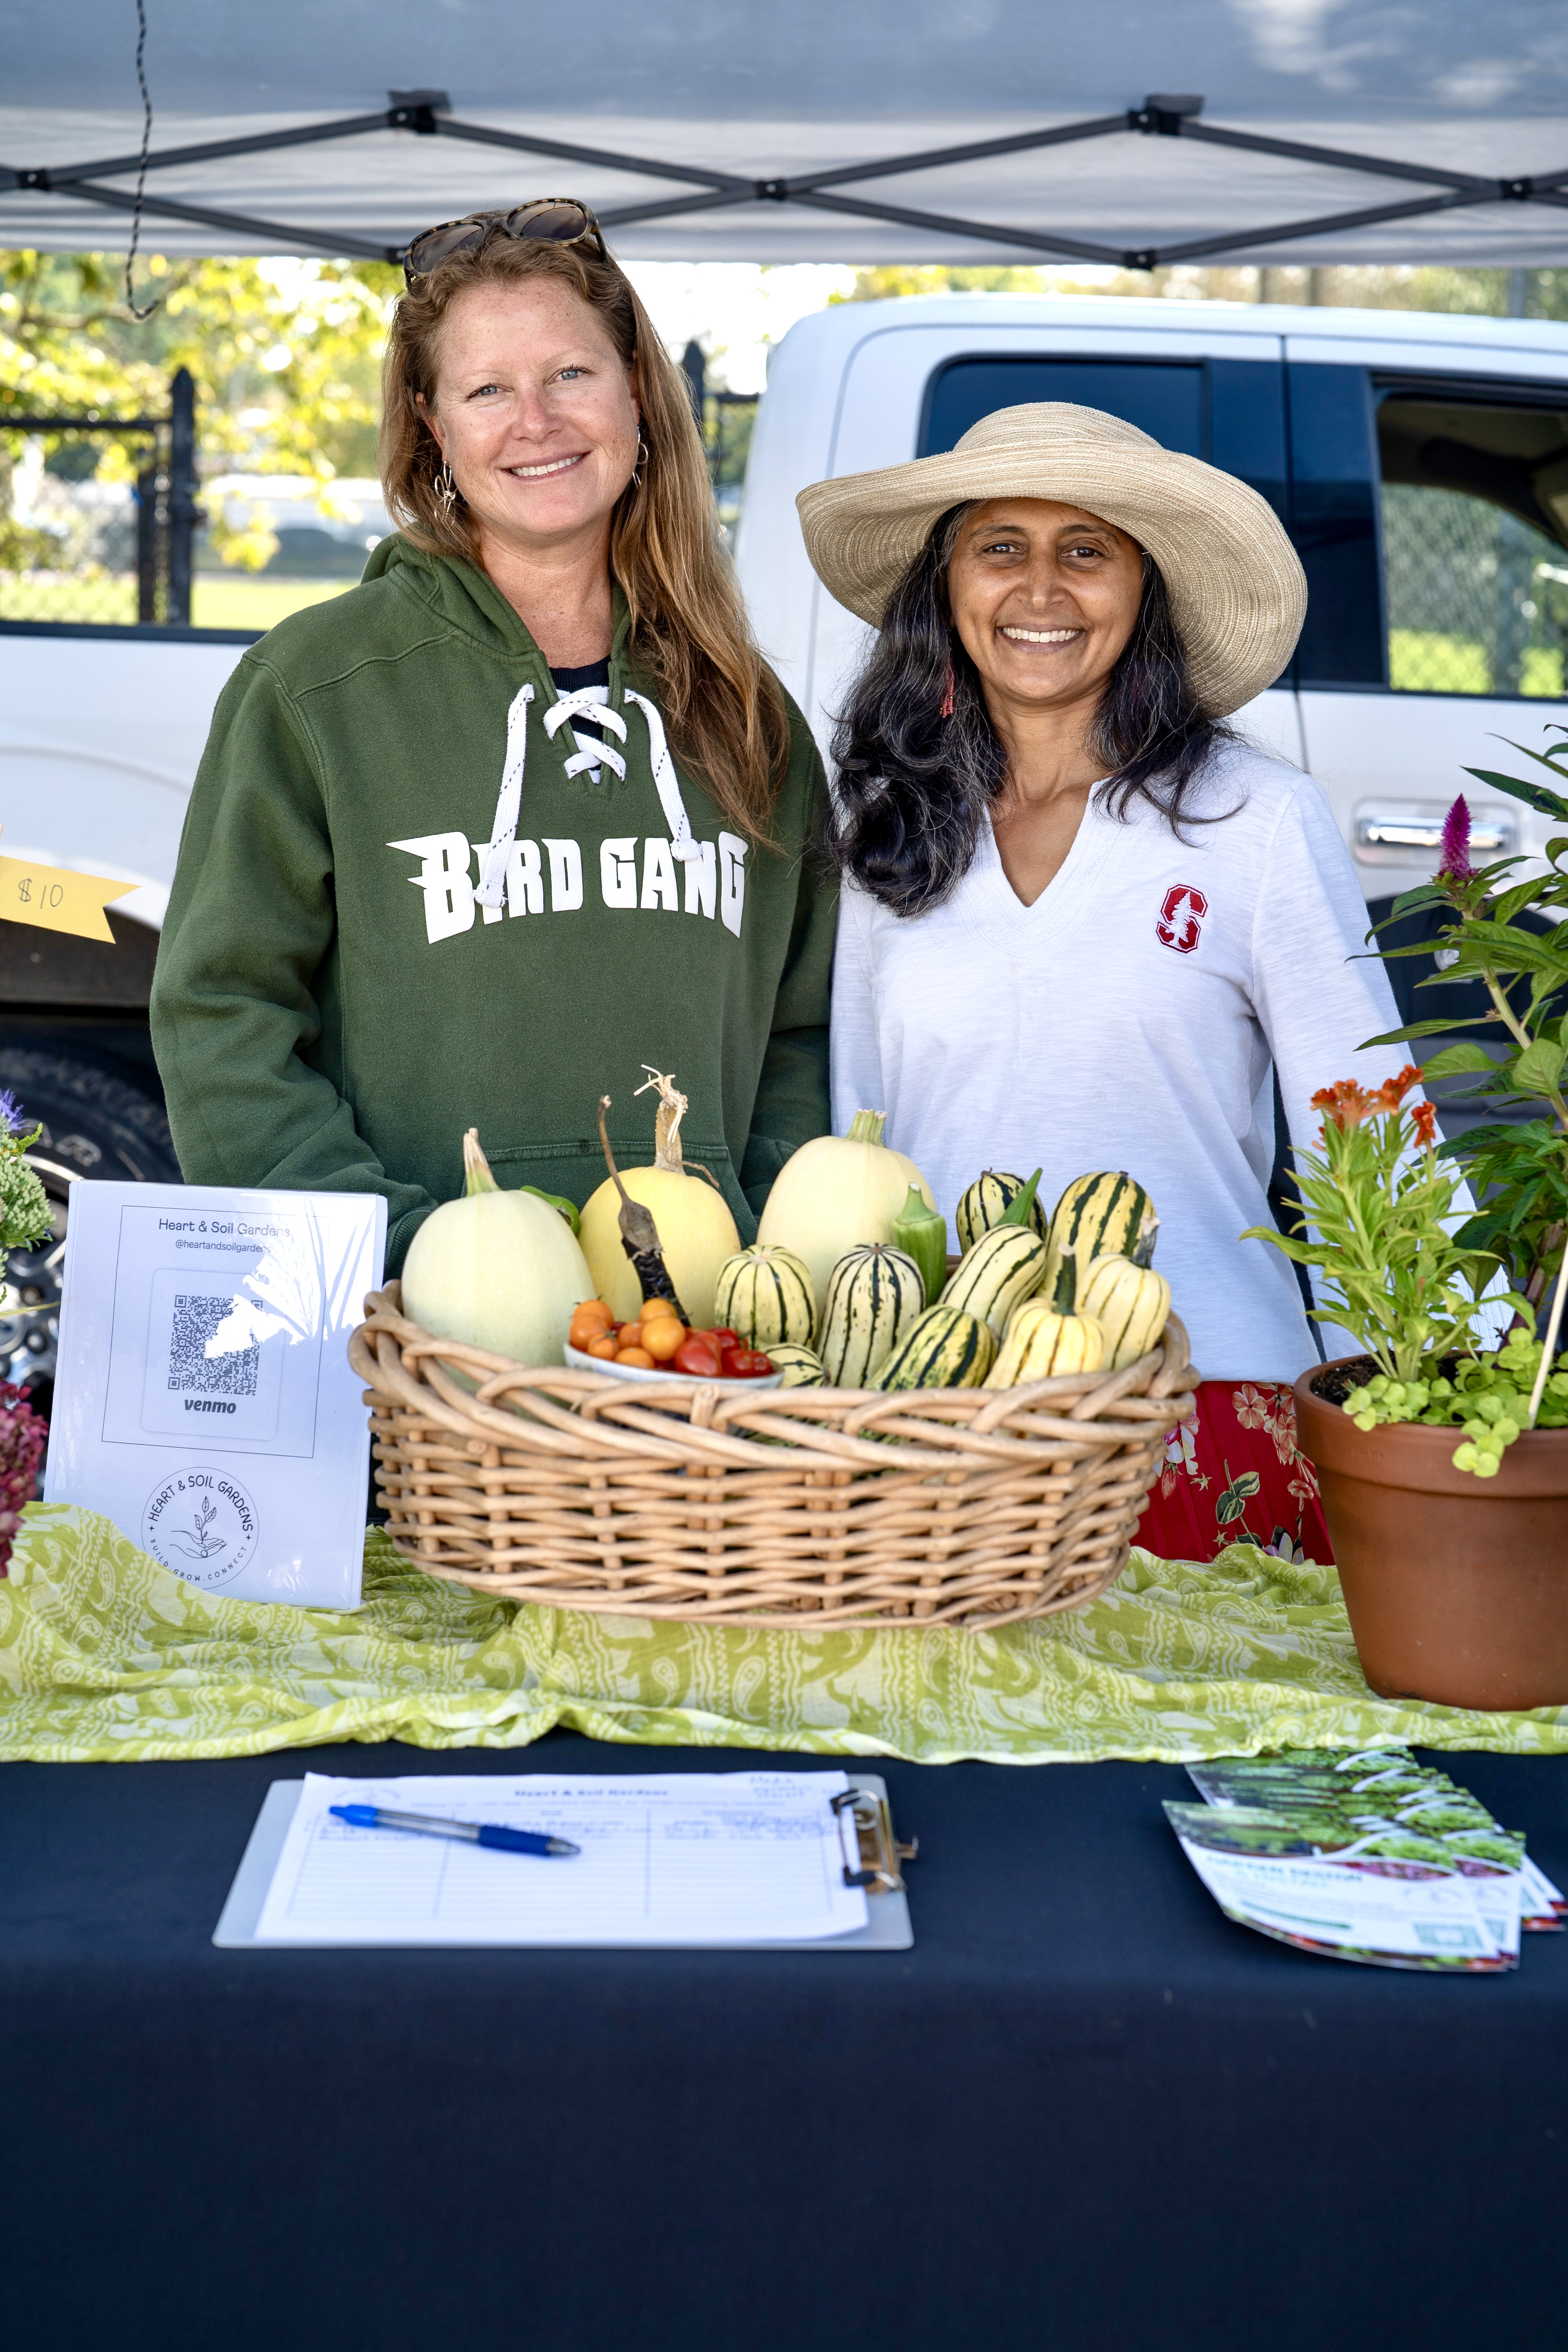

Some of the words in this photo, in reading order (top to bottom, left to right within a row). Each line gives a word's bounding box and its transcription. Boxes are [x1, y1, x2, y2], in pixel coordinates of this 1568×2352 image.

[18, 878, 64, 909] $10
[600, 831, 749, 938] GANG
[1156, 884, 1208, 954] S
[158, 1218, 195, 1232] Heart
[198, 1220, 207, 1232] &
[211, 1221, 234, 1234] Soil
[237, 1223, 290, 1237] Gardens
[175, 1239, 271, 1253] @heartandsoilgardens
[184, 1399, 236, 1414] venmo
[148, 1485, 175, 1522] HEART
[178, 1480, 186, 1491] &
[188, 1475, 214, 1488] SOIL
[218, 1481, 253, 1532] GARDENS
